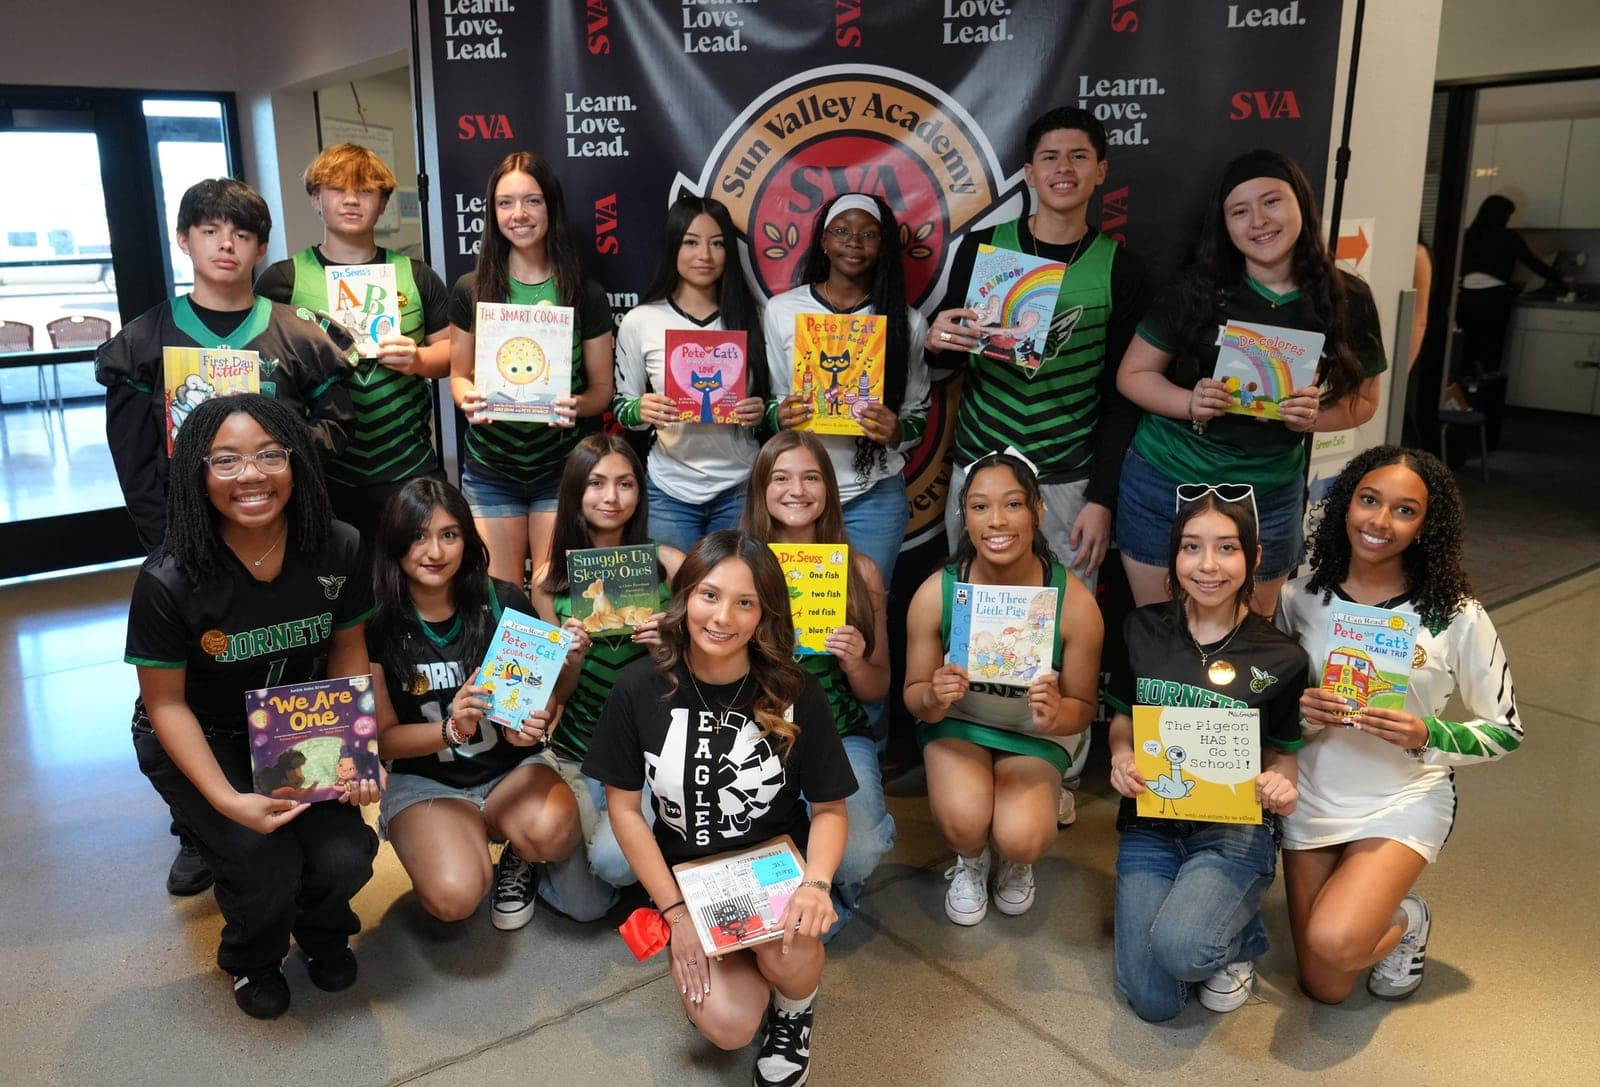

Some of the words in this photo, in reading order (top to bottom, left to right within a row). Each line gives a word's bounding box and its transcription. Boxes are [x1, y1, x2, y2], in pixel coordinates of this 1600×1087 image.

[683, 7, 744, 28] Love.
[944, 0, 1012, 18] Love.
[1227, 1, 1306, 28] Lead.
[445, 16, 503, 36] Love.
[835, 0, 862, 48] SV
[943, 19, 1014, 45] Lead.
[446, 37, 507, 60] Lead.
[684, 29, 748, 53] Lead.
[1078, 75, 1165, 97] Learn.
[565, 93, 637, 112] Learn.
[1078, 99, 1148, 121] ove.
[1229, 90, 1301, 121] SVA
[458, 114, 514, 140] SVA
[566, 114, 625, 134] Love.
[567, 136, 629, 157] Lead.
[722, 139, 772, 198] Sun
[763, 95, 856, 140] Valley
[862, 92, 977, 194] Academy
[788, 164, 909, 214] SVA
[595, 193, 619, 255] SVA
[332, 271, 345, 280] Dr.
[480, 308, 495, 320] THE
[500, 308, 530, 322] SMART
[534, 310, 569, 325] COOKIE
[807, 317, 838, 333] Pete
[850, 319, 876, 334] Cat
[682, 346, 705, 358] Pete
[713, 347, 738, 359] Cat's
[1239, 335, 1255, 347] De
[1260, 335, 1305, 356] colores
[203, 355, 230, 367] First
[232, 356, 254, 371] Day
[209, 364, 250, 379] Jitters
[573, 551, 628, 568] Snuggle
[780, 552, 795, 564] Dr.
[797, 551, 823, 564] Seuss
[574, 568, 617, 583] Sleepy
[620, 565, 652, 578] Ones
[825, 571, 839, 579] fish
[827, 590, 841, 598] fish
[976, 591, 996, 603] The
[998, 592, 1027, 604] Three
[822, 608, 836, 616] fish
[976, 604, 1003, 616] Little
[1005, 605, 1026, 617] Pigs
[215, 612, 333, 663] HORNETS
[501, 630, 527, 649] Pete
[536, 644, 557, 660] Cat
[1333, 623, 1363, 640] Pete
[1375, 633, 1409, 650] Cat's
[1365, 645, 1388, 655] TRAIN
[1391, 649, 1408, 658] TRIP
[1336, 685, 1354, 696] CAT
[269, 696, 309, 714] We
[310, 690, 353, 712] Are
[290, 710, 339, 731] One
[1165, 721, 1191, 731] The
[1196, 721, 1249, 733] Pigeon
[1200, 735, 1227, 745] HAS
[1233, 736, 1250, 745] to
[1209, 748, 1227, 757] Go
[1234, 748, 1250, 757] to
[1190, 759, 1251, 769] School!
[694, 711, 714, 846] EAGLES
